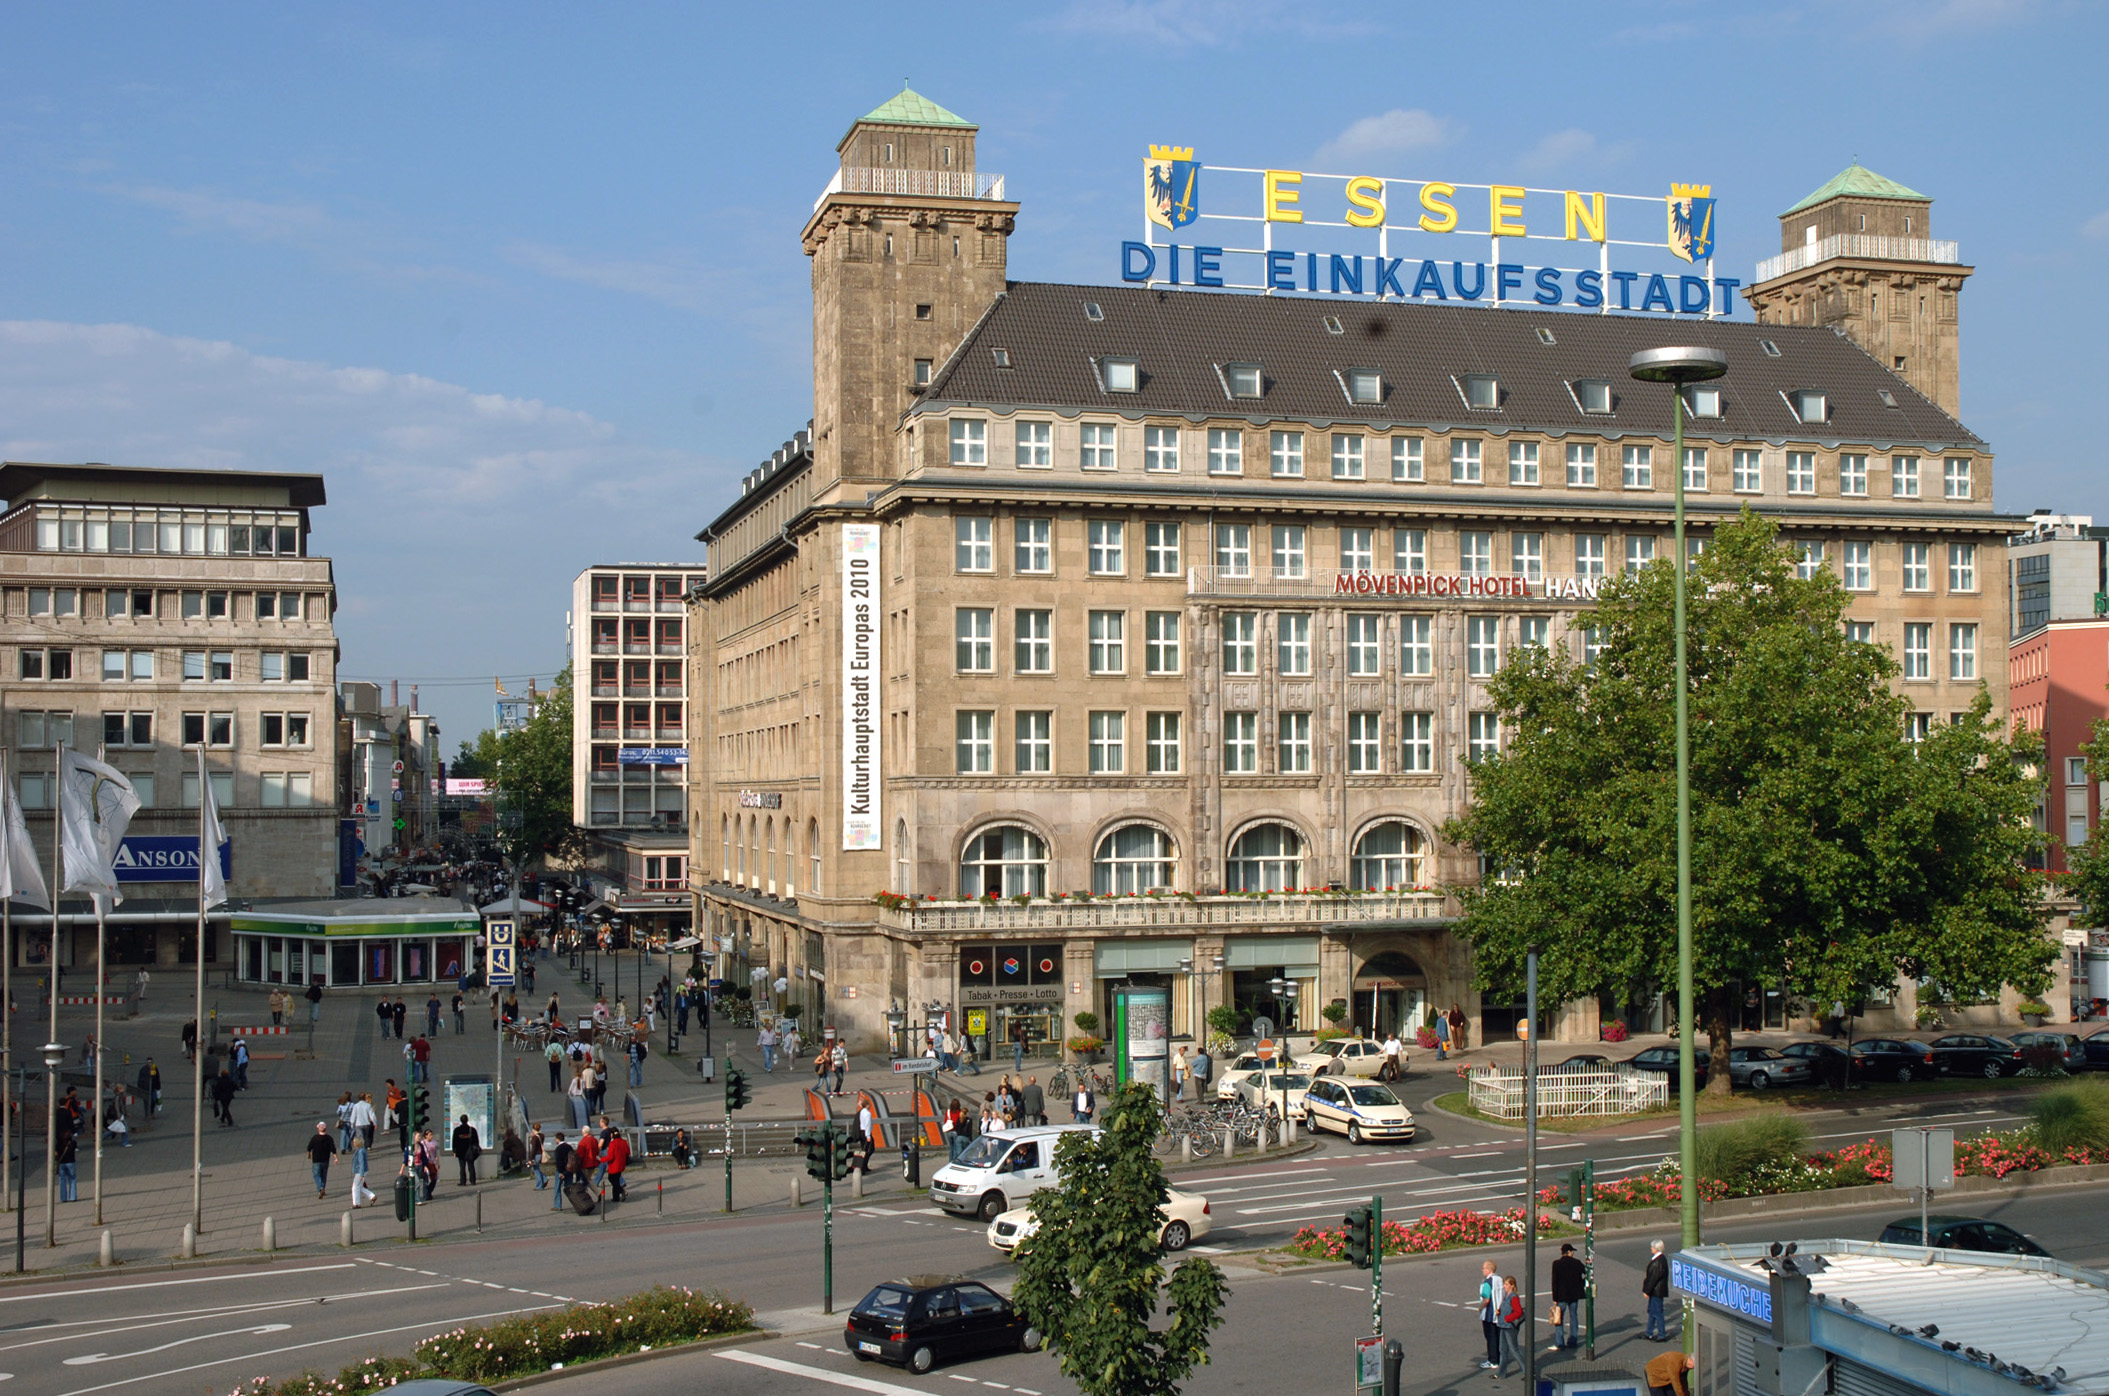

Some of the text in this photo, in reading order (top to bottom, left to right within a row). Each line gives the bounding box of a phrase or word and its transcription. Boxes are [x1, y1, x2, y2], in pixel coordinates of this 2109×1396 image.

[1265, 169, 1606, 242] ESSEN
[1121, 240, 1741, 316] DIE EINKAUFSSTADT
[850, 559, 869, 598] 2010
[1333, 569, 1462, 595] MÖVENPICK
[1469, 576, 1533, 596] HOTEL
[850, 604, 874, 670] Europas
[850, 674, 874, 814] Kulturhauptstadt
[968, 988, 1057, 1000] Tabak Presse Lotto
